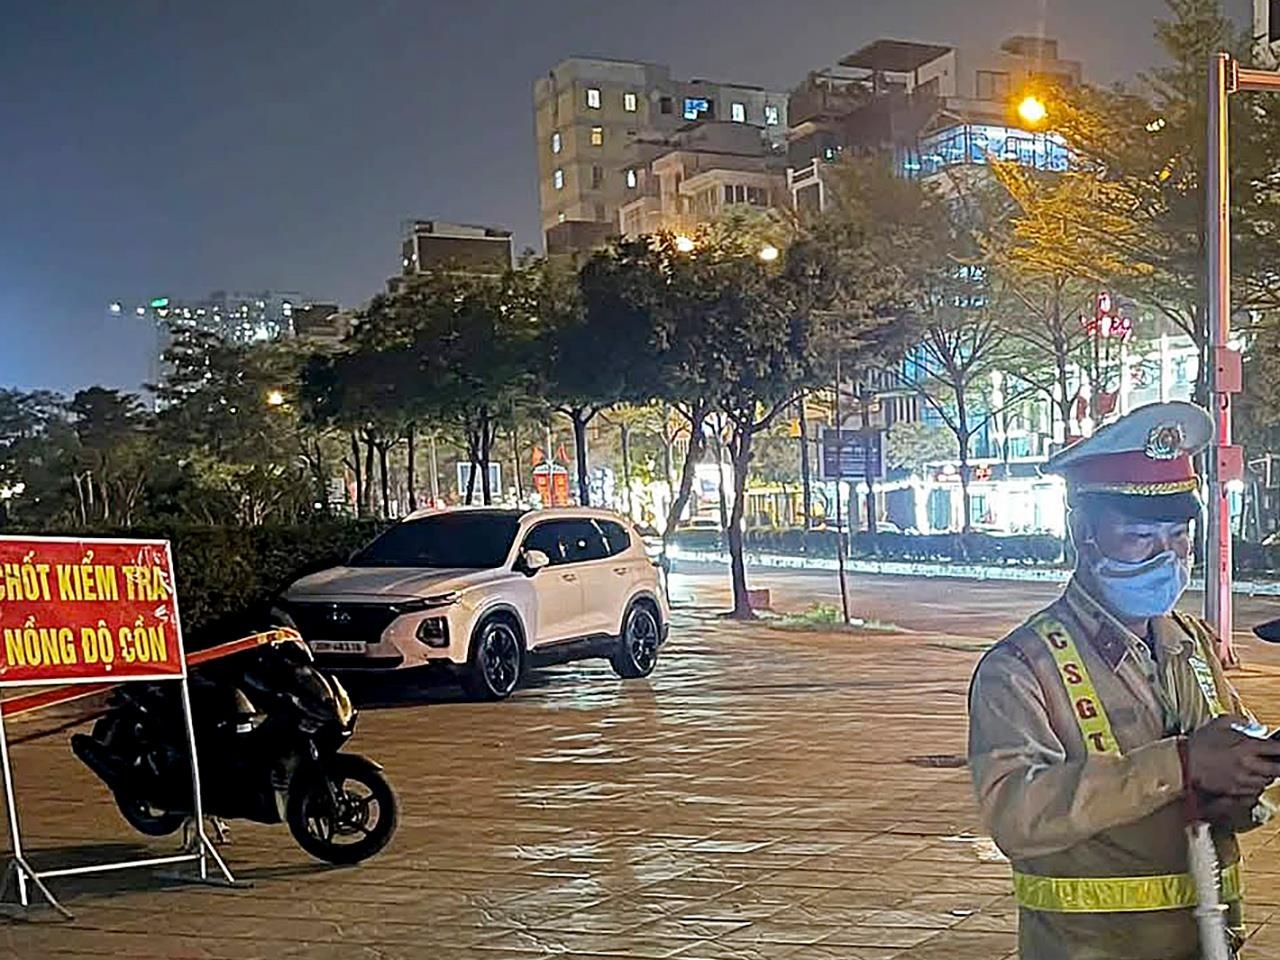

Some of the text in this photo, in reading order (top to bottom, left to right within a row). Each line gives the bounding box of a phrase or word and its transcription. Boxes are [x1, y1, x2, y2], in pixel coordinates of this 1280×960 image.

[56, 550, 119, 601] KIỂM
[121, 565, 169, 601] TRA
[4, 614, 168, 671] NỒNG ĐỘ CỒN
